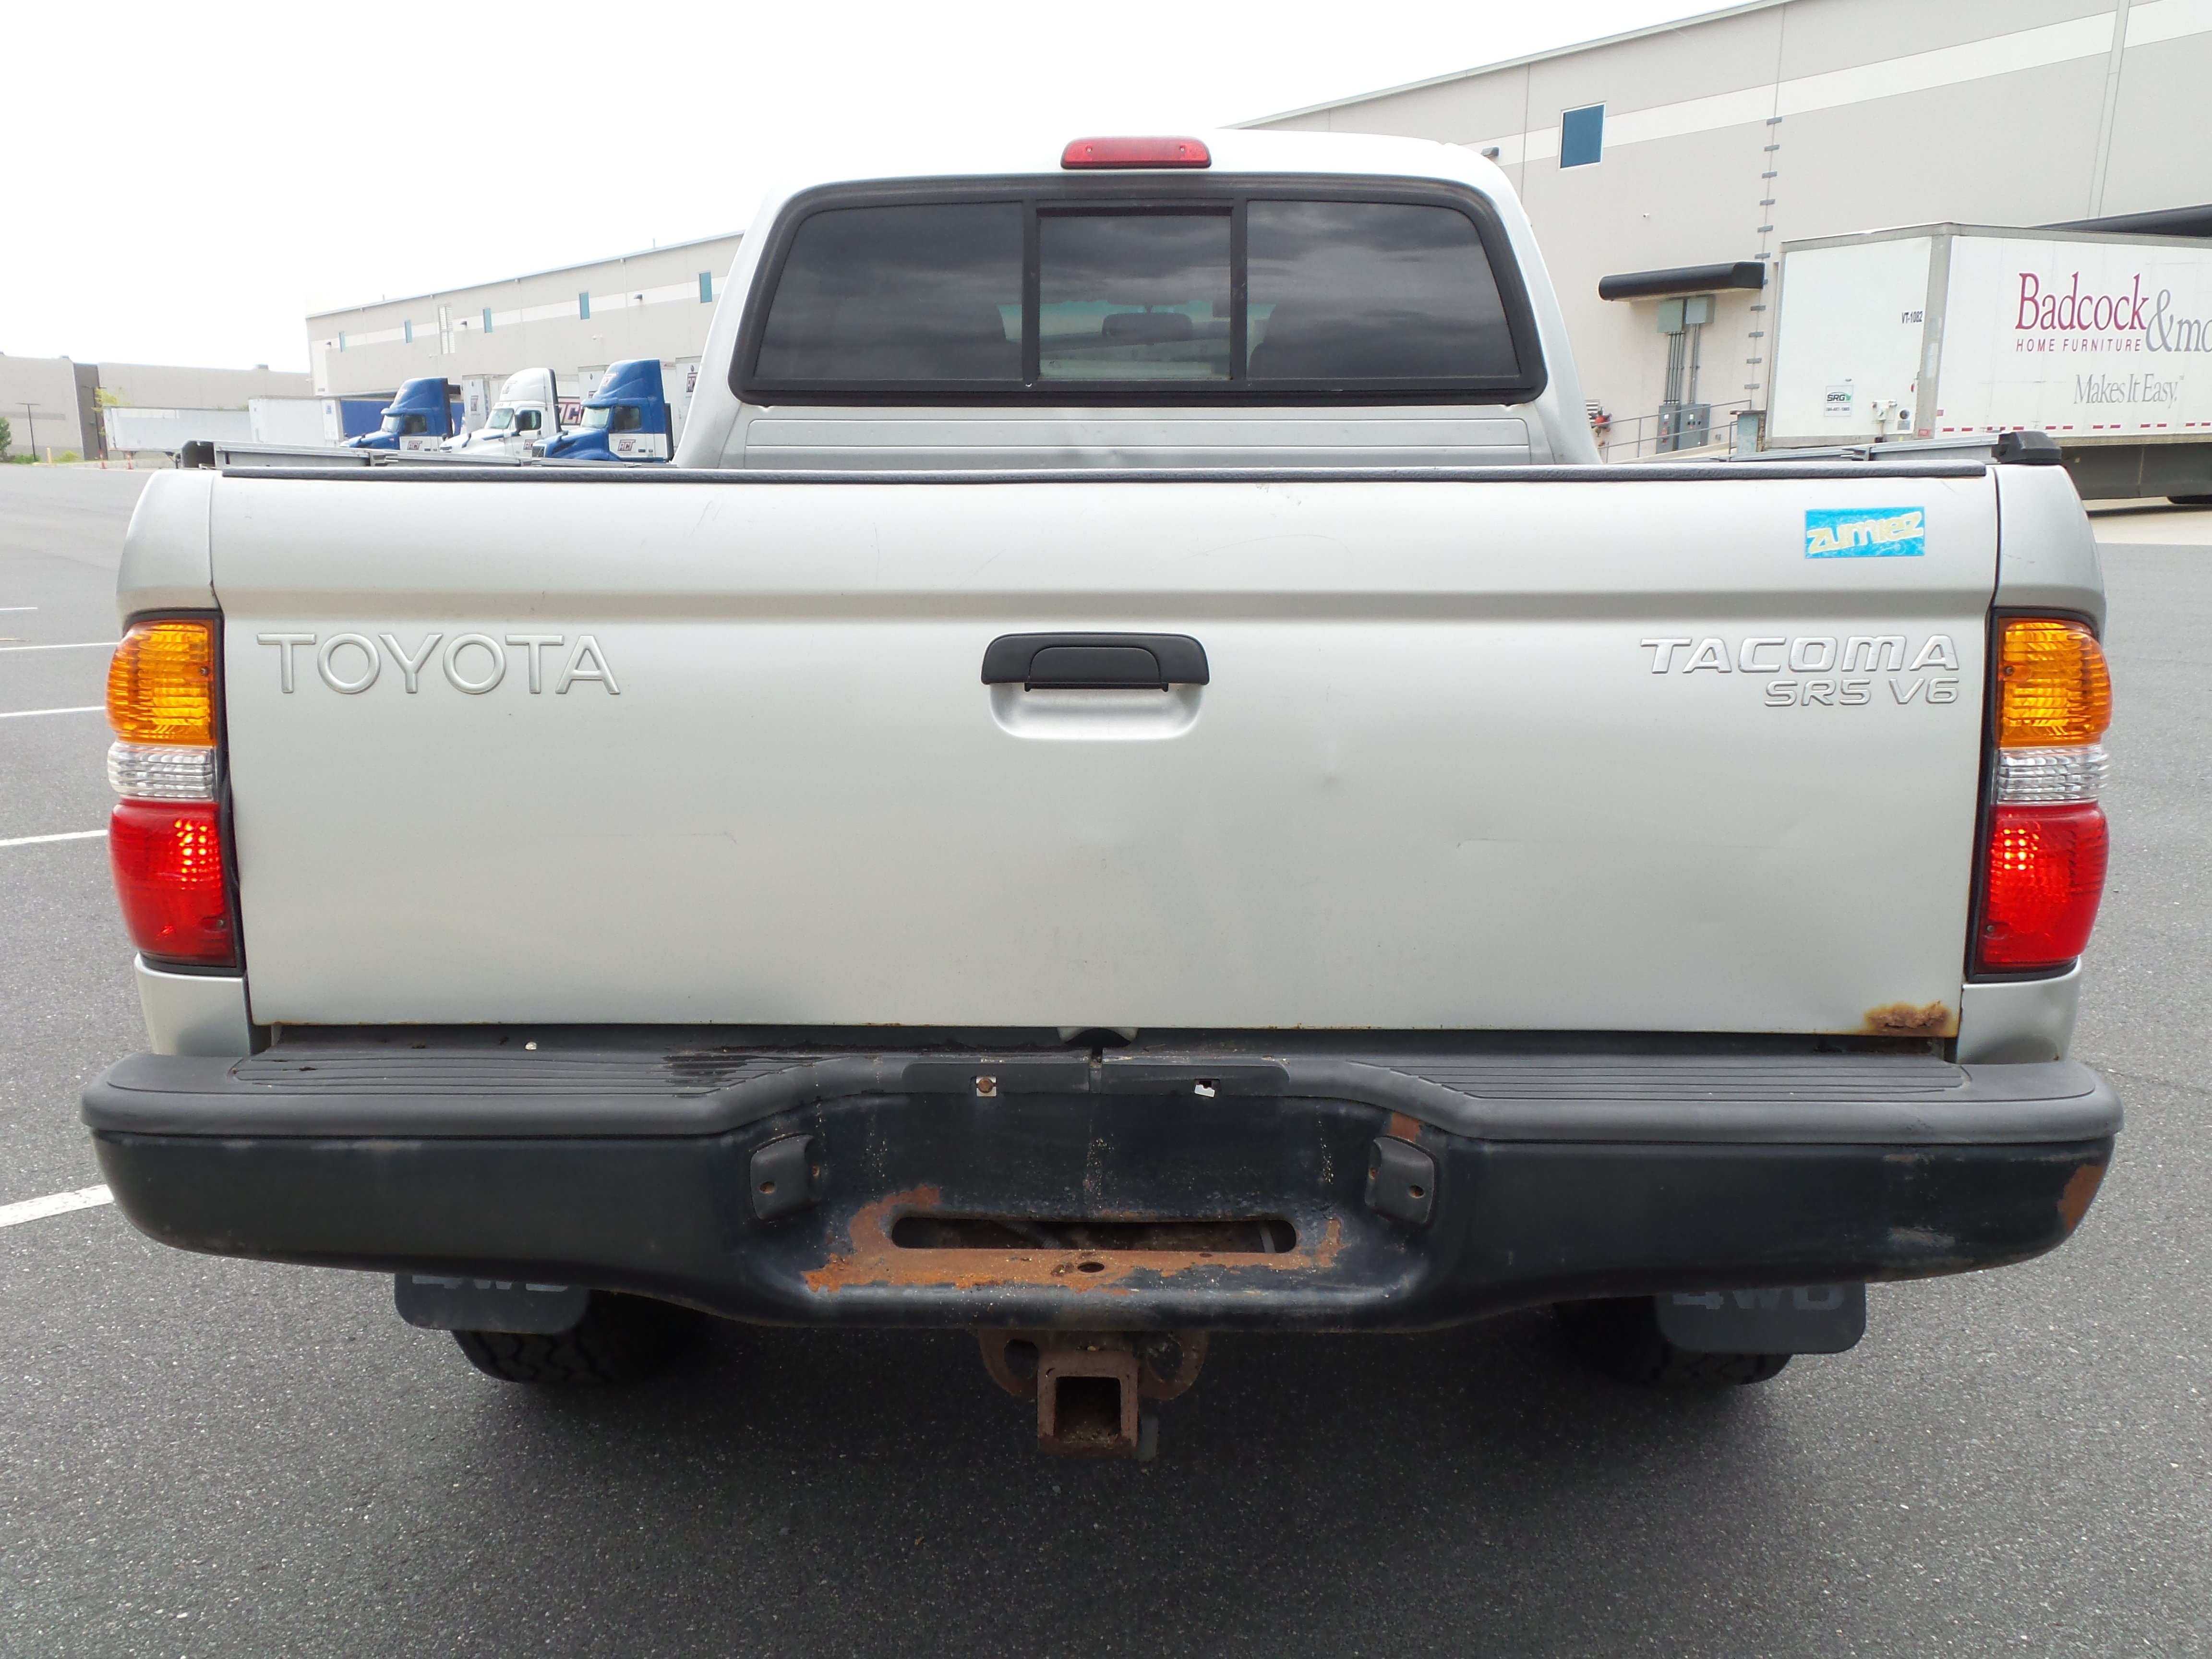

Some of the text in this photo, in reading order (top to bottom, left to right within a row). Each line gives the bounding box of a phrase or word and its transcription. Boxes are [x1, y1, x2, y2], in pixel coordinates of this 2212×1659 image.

[2015, 271, 2149, 330] Badcock
[2016, 338, 2141, 352] HOME FURNITURE
[2074, 373, 2178, 409] Makes It Easy.
[618, 439, 636, 451] ACT
[1807, 511, 1923, 554] zumiez
[256, 633, 621, 695] TOYOTA
[1640, 634, 1960, 674] TACOMA
[1765, 677, 1960, 707] SR5 V6
